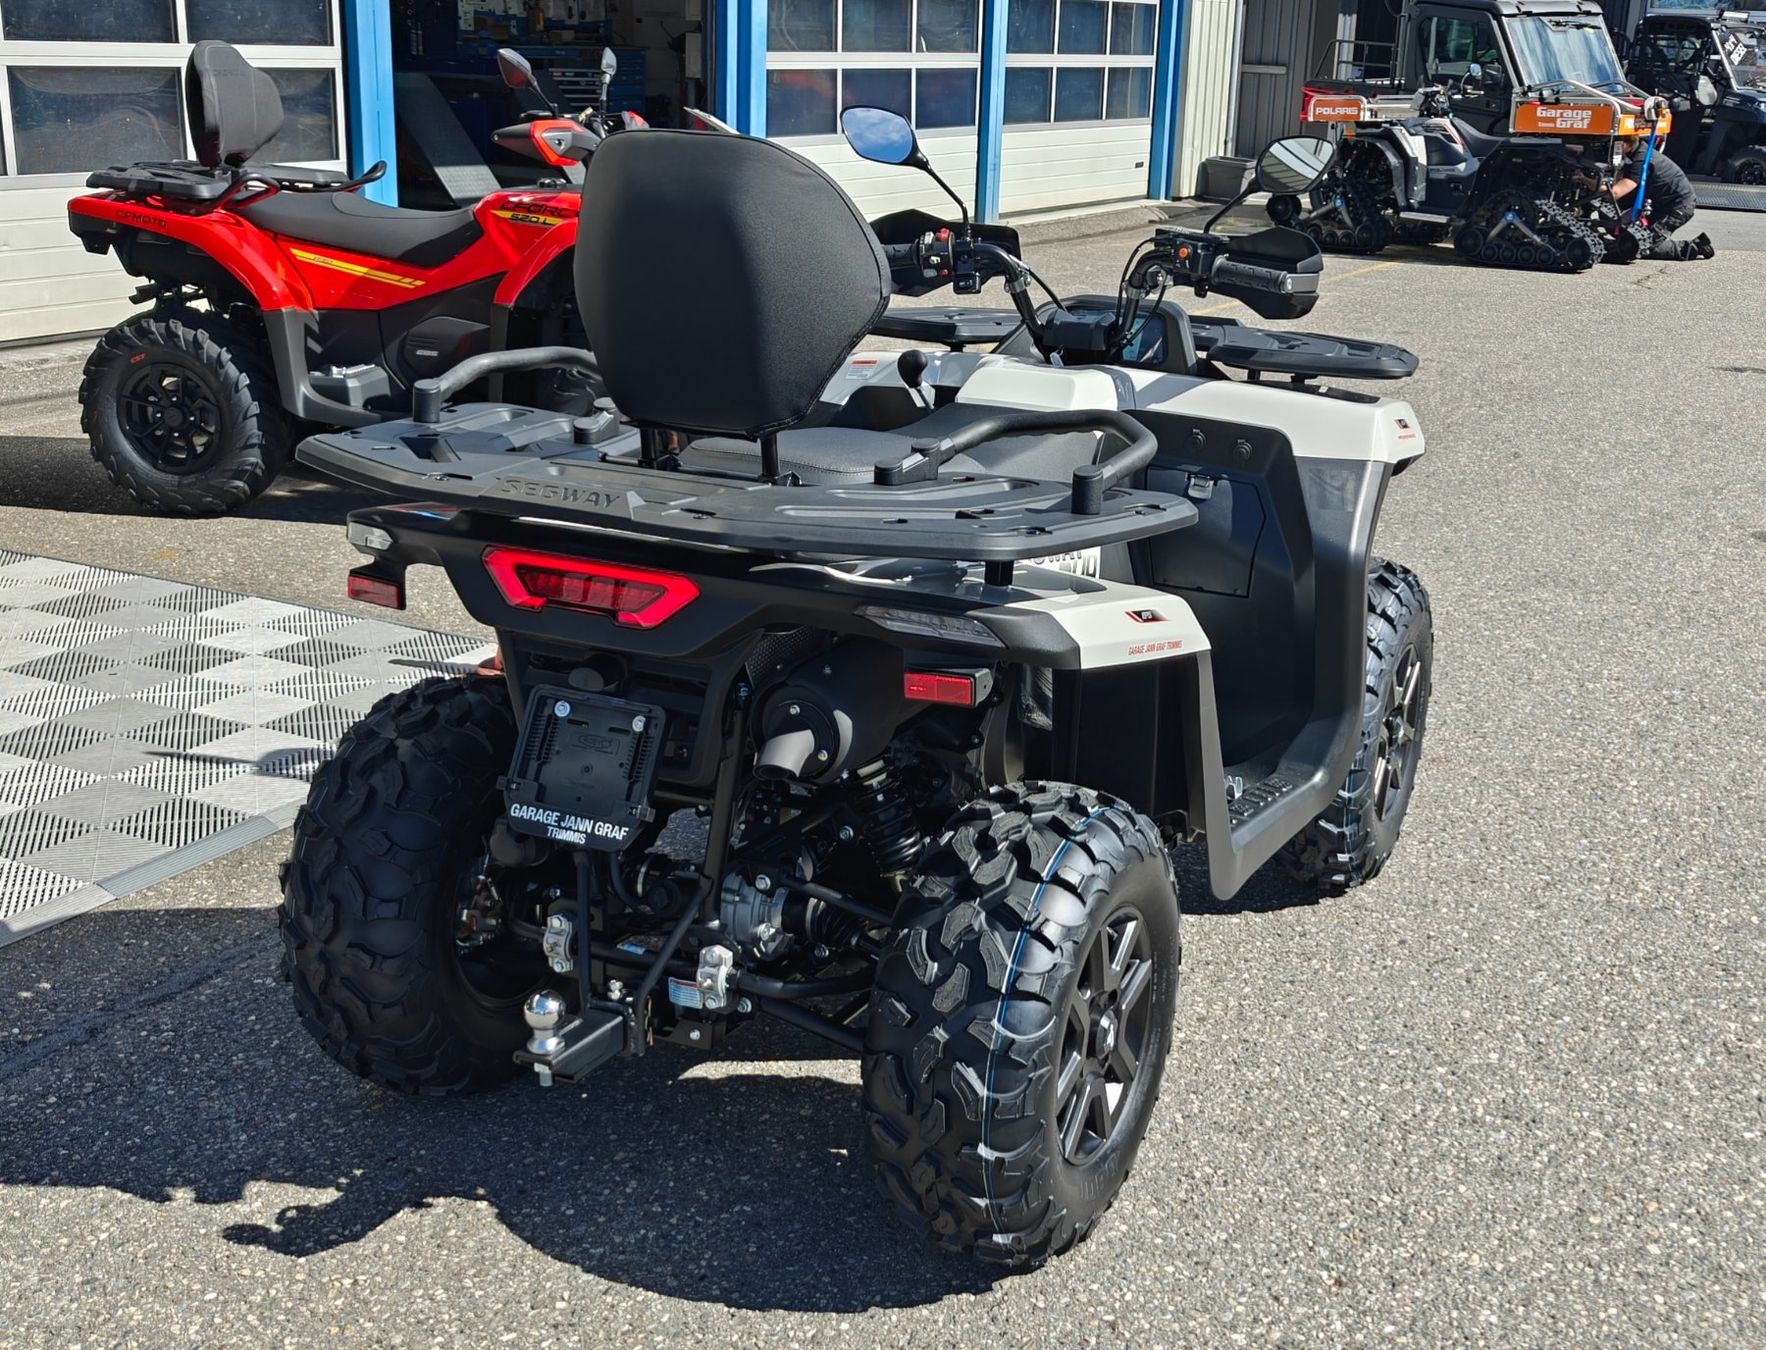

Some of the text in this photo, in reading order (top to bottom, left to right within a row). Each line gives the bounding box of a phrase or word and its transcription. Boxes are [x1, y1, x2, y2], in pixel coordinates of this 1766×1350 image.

[1315, 107, 1359, 115] POLARIS
[1536, 106, 1592, 120] Garage
[1556, 118, 1591, 129] Graf
[500, 201, 580, 218] CFORC
[511, 212, 540, 224] 520
[501, 478, 620, 509] SEGWAY
[510, 803, 629, 841] GARAGE JANN GRAF
[547, 825, 587, 845] TRIMMIS
